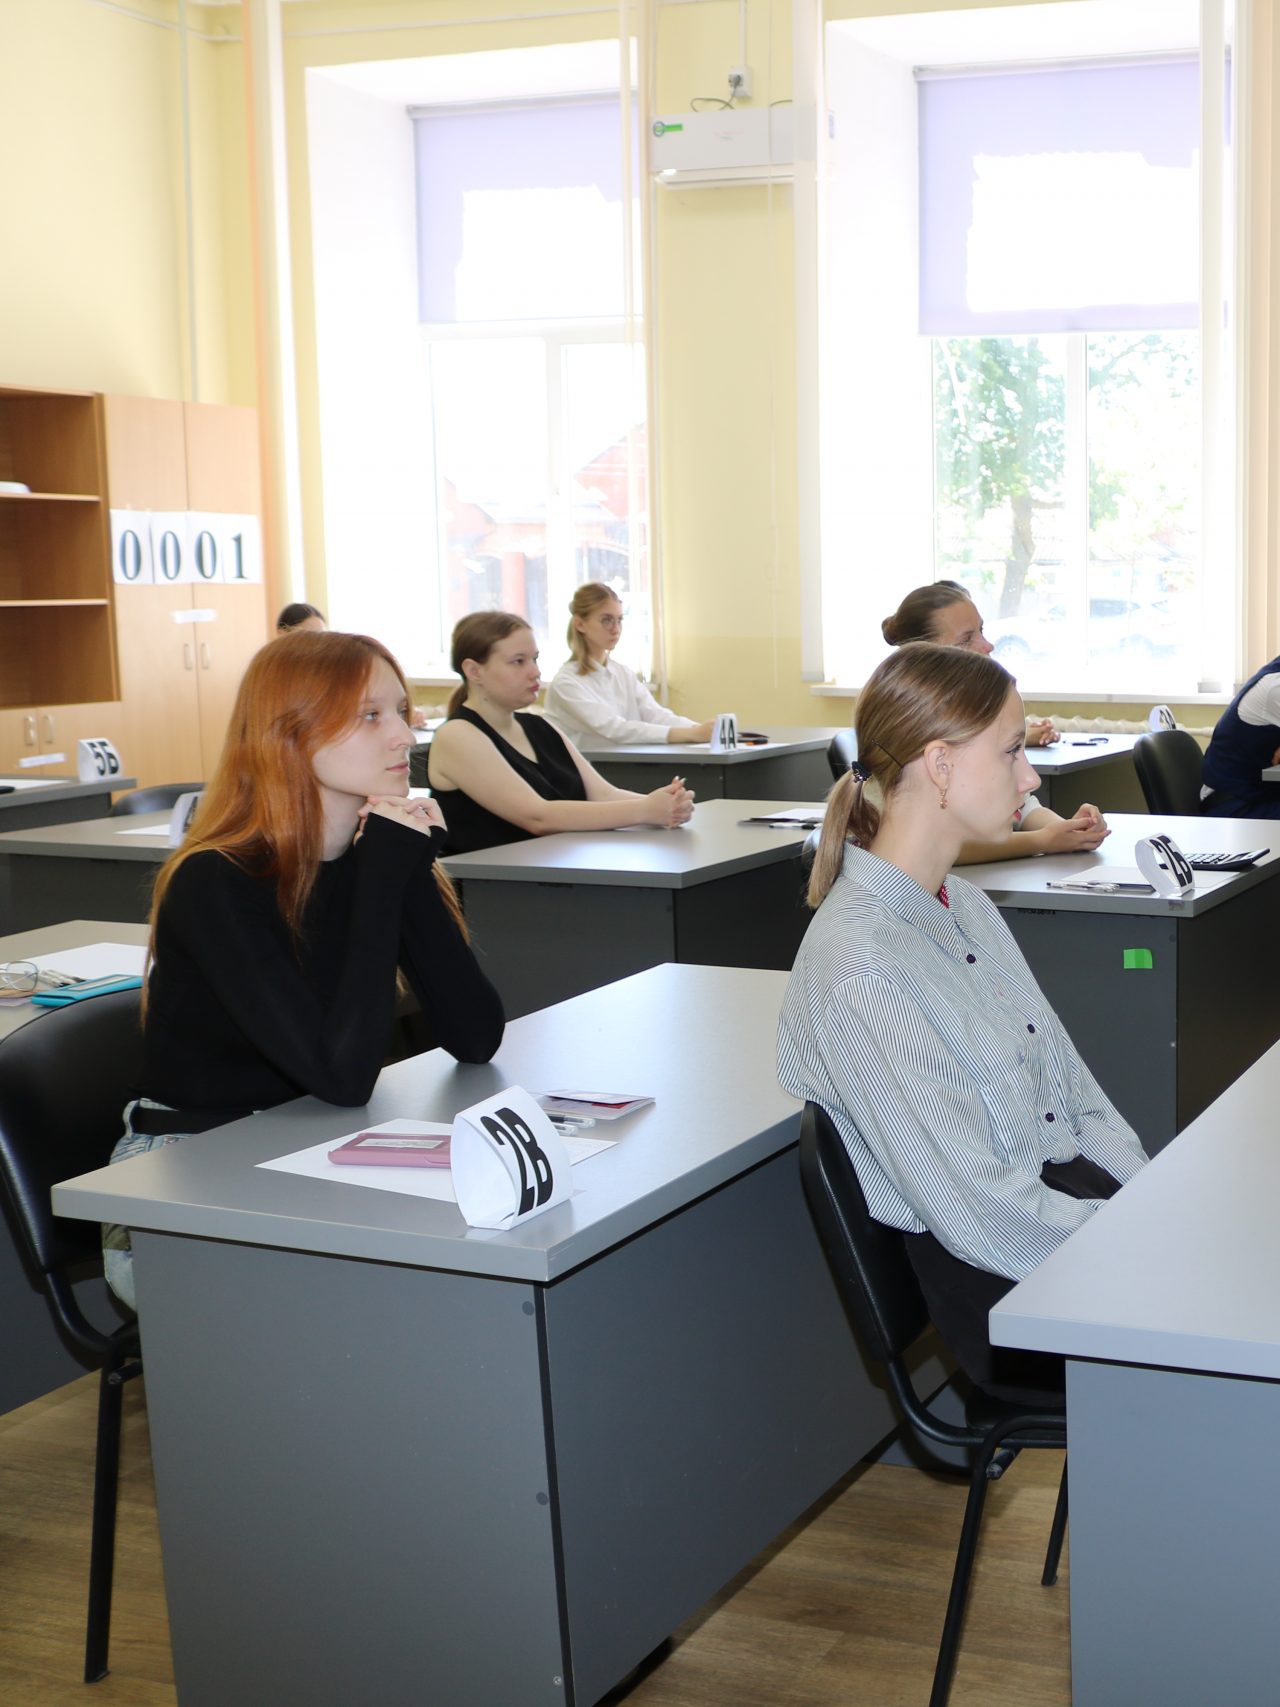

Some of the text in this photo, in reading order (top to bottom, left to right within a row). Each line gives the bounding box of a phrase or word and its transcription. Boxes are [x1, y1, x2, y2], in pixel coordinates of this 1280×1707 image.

[119, 529, 249, 581] 0001
[1149, 835, 1193, 888] 2Б
[480, 1107, 554, 1216] 2В
